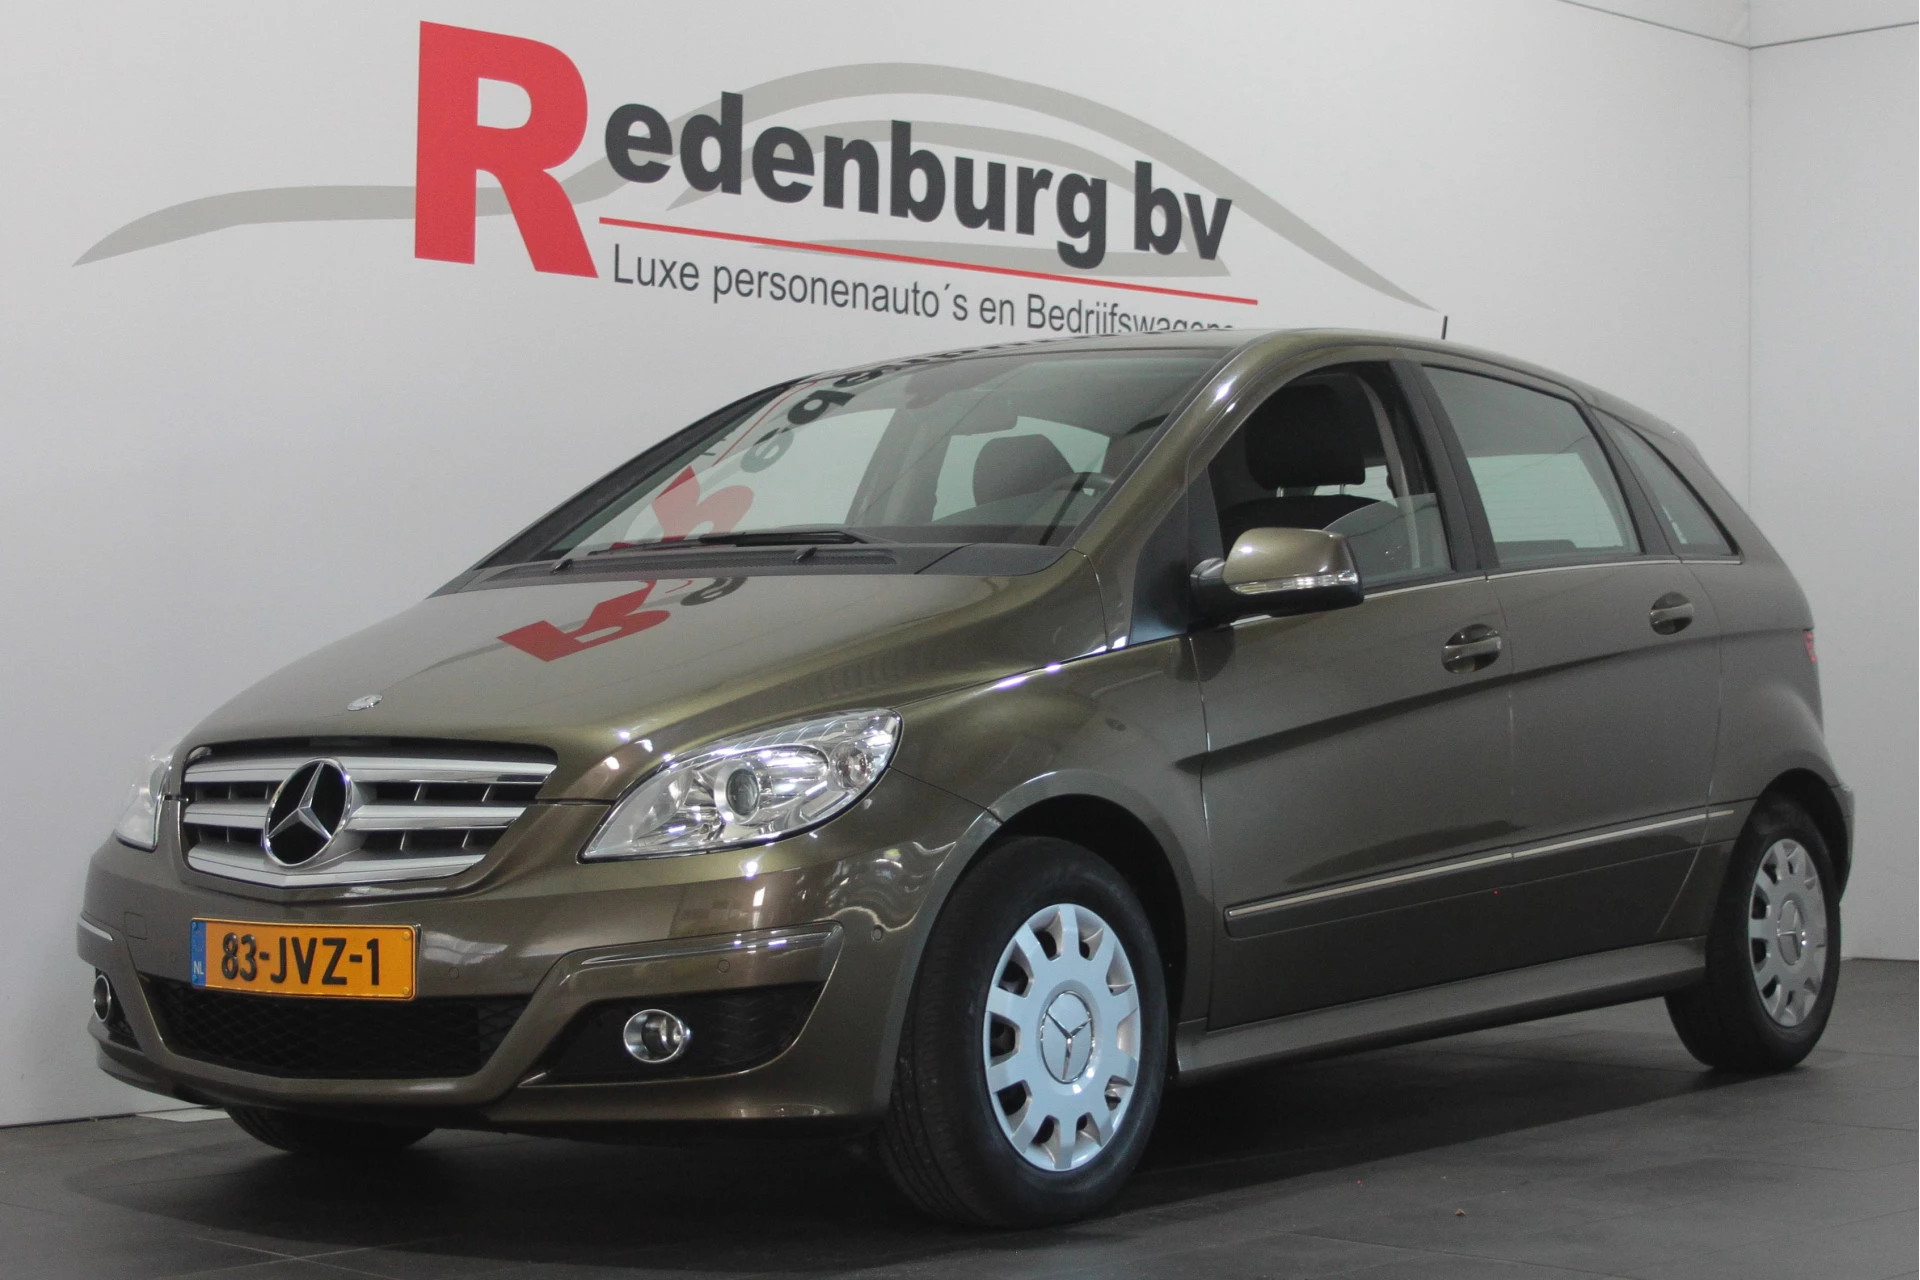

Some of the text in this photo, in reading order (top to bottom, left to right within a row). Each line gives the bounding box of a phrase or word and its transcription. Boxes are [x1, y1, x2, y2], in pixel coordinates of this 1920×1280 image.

[415, 20, 1232, 278] Redenburg bv
[614, 243, 699, 291] Luxe
[979, 294, 1015, 326] en
[1026, 293, 1234, 335] Bedrijfswa
[193, 961, 204, 975] NL
[221, 932, 380, 986] 83-JVZ-1
